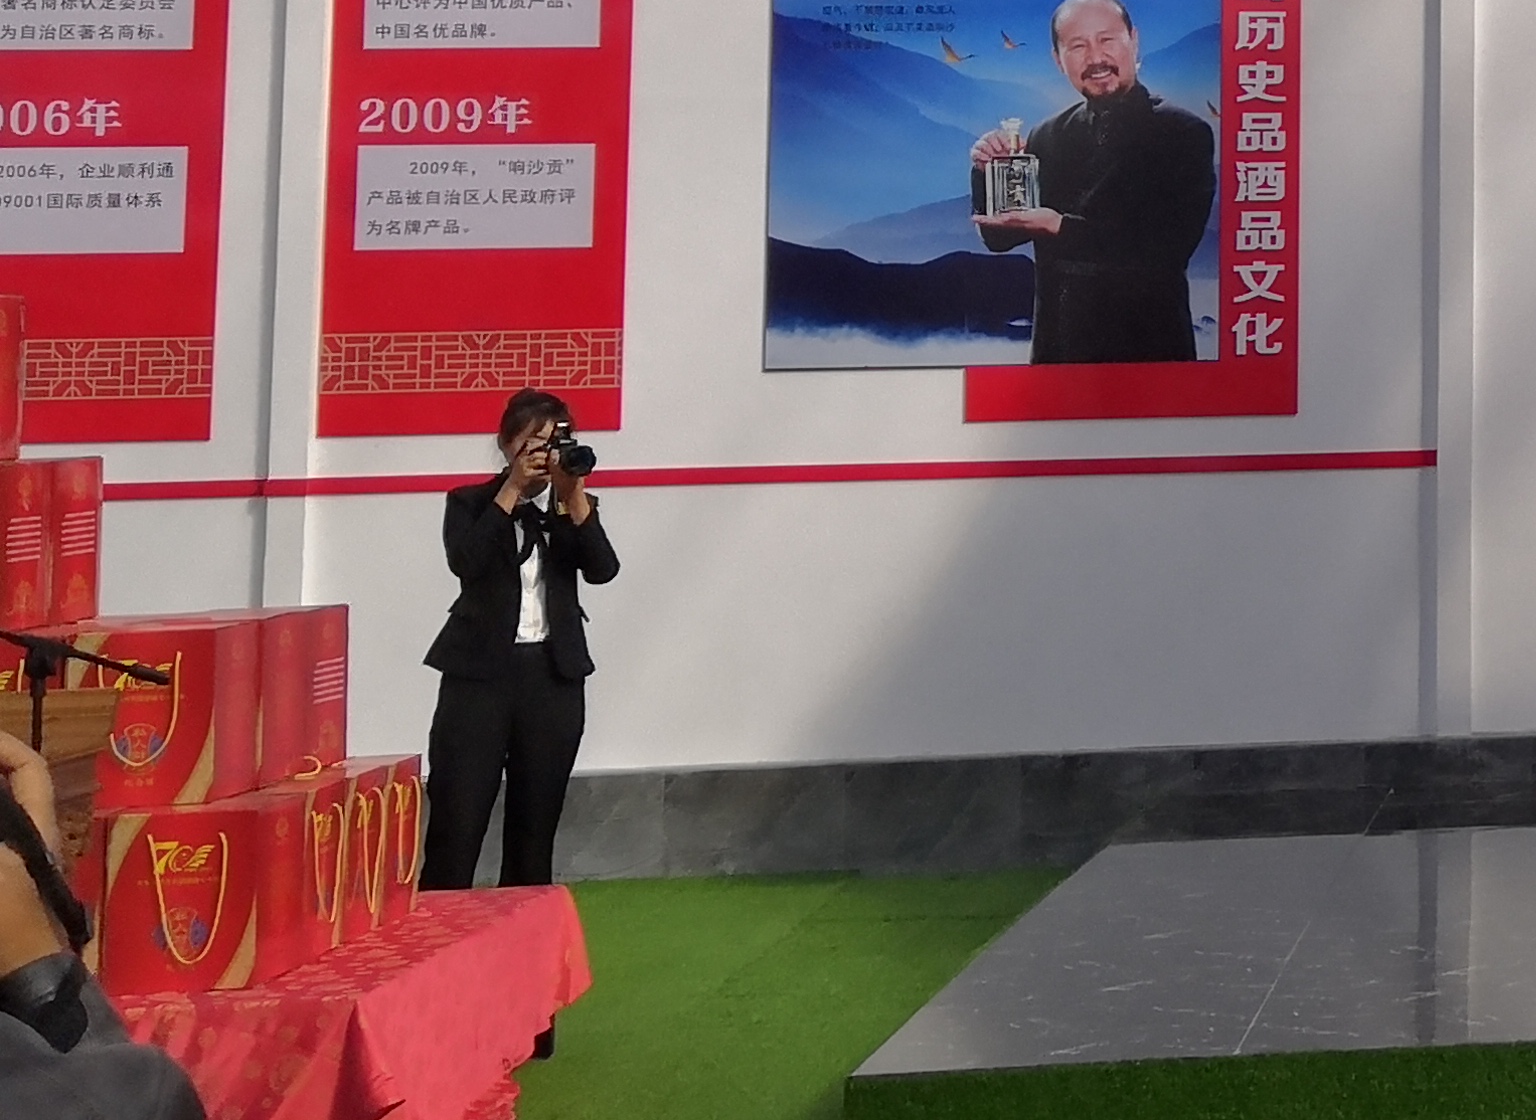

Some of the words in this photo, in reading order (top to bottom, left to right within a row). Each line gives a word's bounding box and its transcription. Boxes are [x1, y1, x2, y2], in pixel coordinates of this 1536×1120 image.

[0, 98, 122, 137] 06年
[358, 95, 532, 134] 2009年
[0, 192, 163, 209] 9001国际质量体系
[366, 188, 576, 205] 产品被自治区人民政府评
